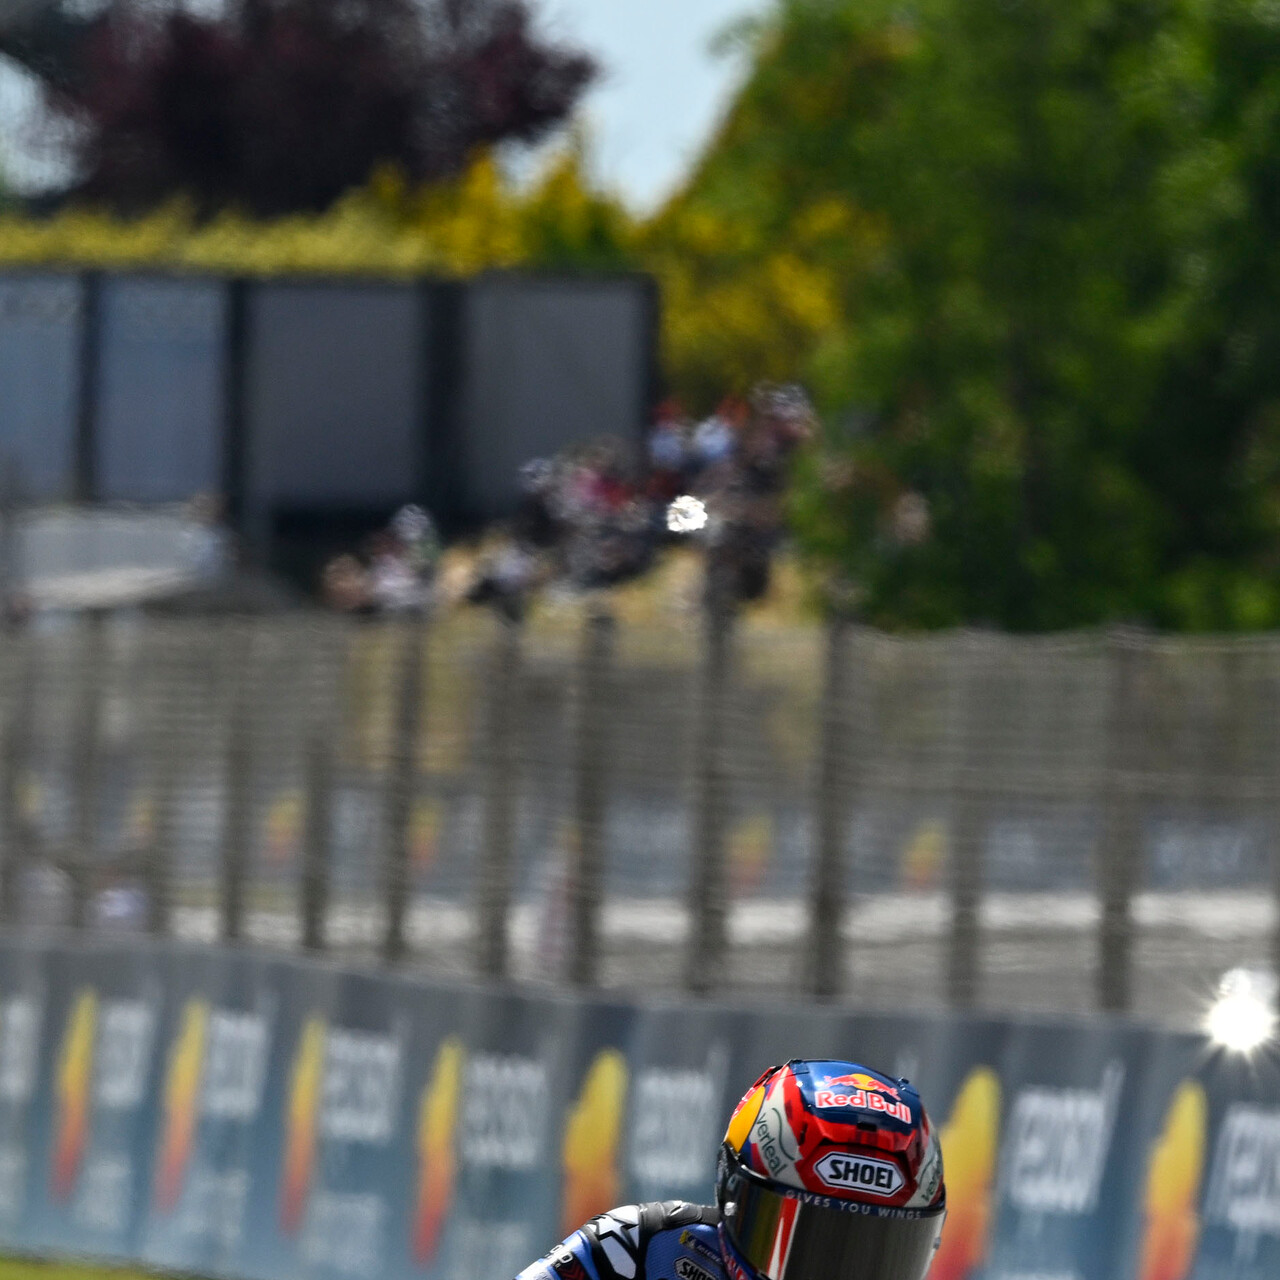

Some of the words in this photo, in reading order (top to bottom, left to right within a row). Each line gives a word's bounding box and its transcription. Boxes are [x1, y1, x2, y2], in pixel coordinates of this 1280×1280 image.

[815, 1089, 864, 1110] Red
[867, 1092, 913, 1125] Bull
[757, 1112, 789, 1177] verleal
[828, 1158, 895, 1190] SHOEI
[784, 1188, 832, 1209] GIVES
[840, 1200, 871, 1217] YOU
[877, 1207, 923, 1221] WINGS
